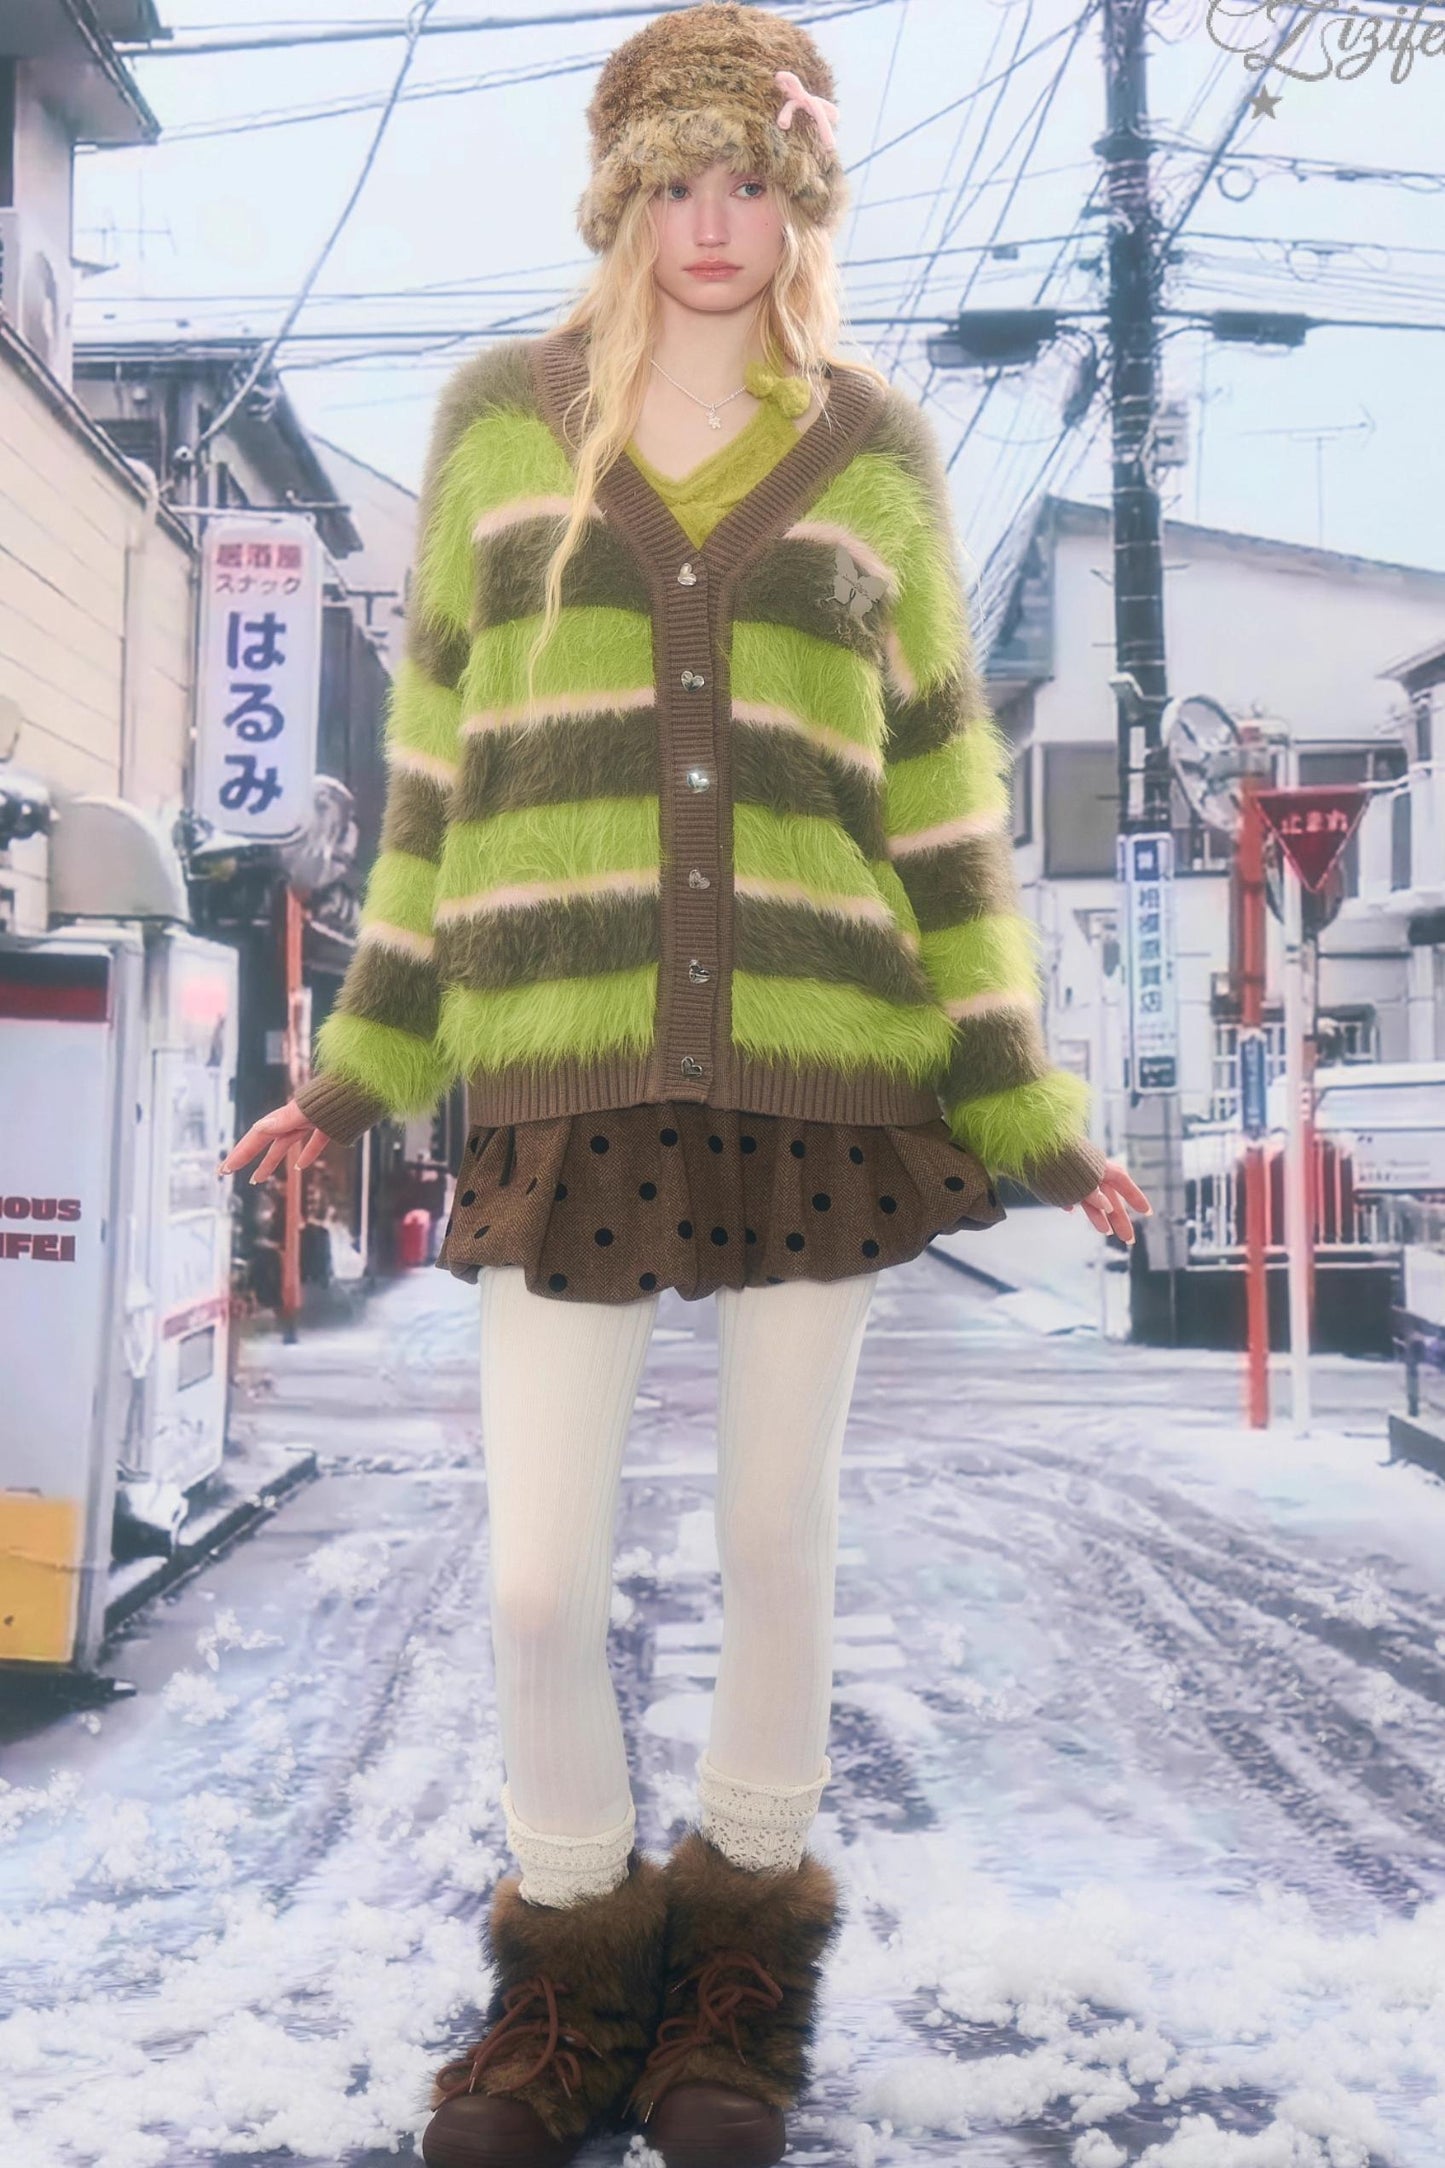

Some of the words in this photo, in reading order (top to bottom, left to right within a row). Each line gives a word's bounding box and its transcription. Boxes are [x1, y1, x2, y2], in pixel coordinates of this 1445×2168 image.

[215, 573, 301, 595] スナック
[218, 611, 287, 816] はるみ
[1281, 809, 1348, 834] 止まれ
[0, 1196, 81, 1222] OUS
